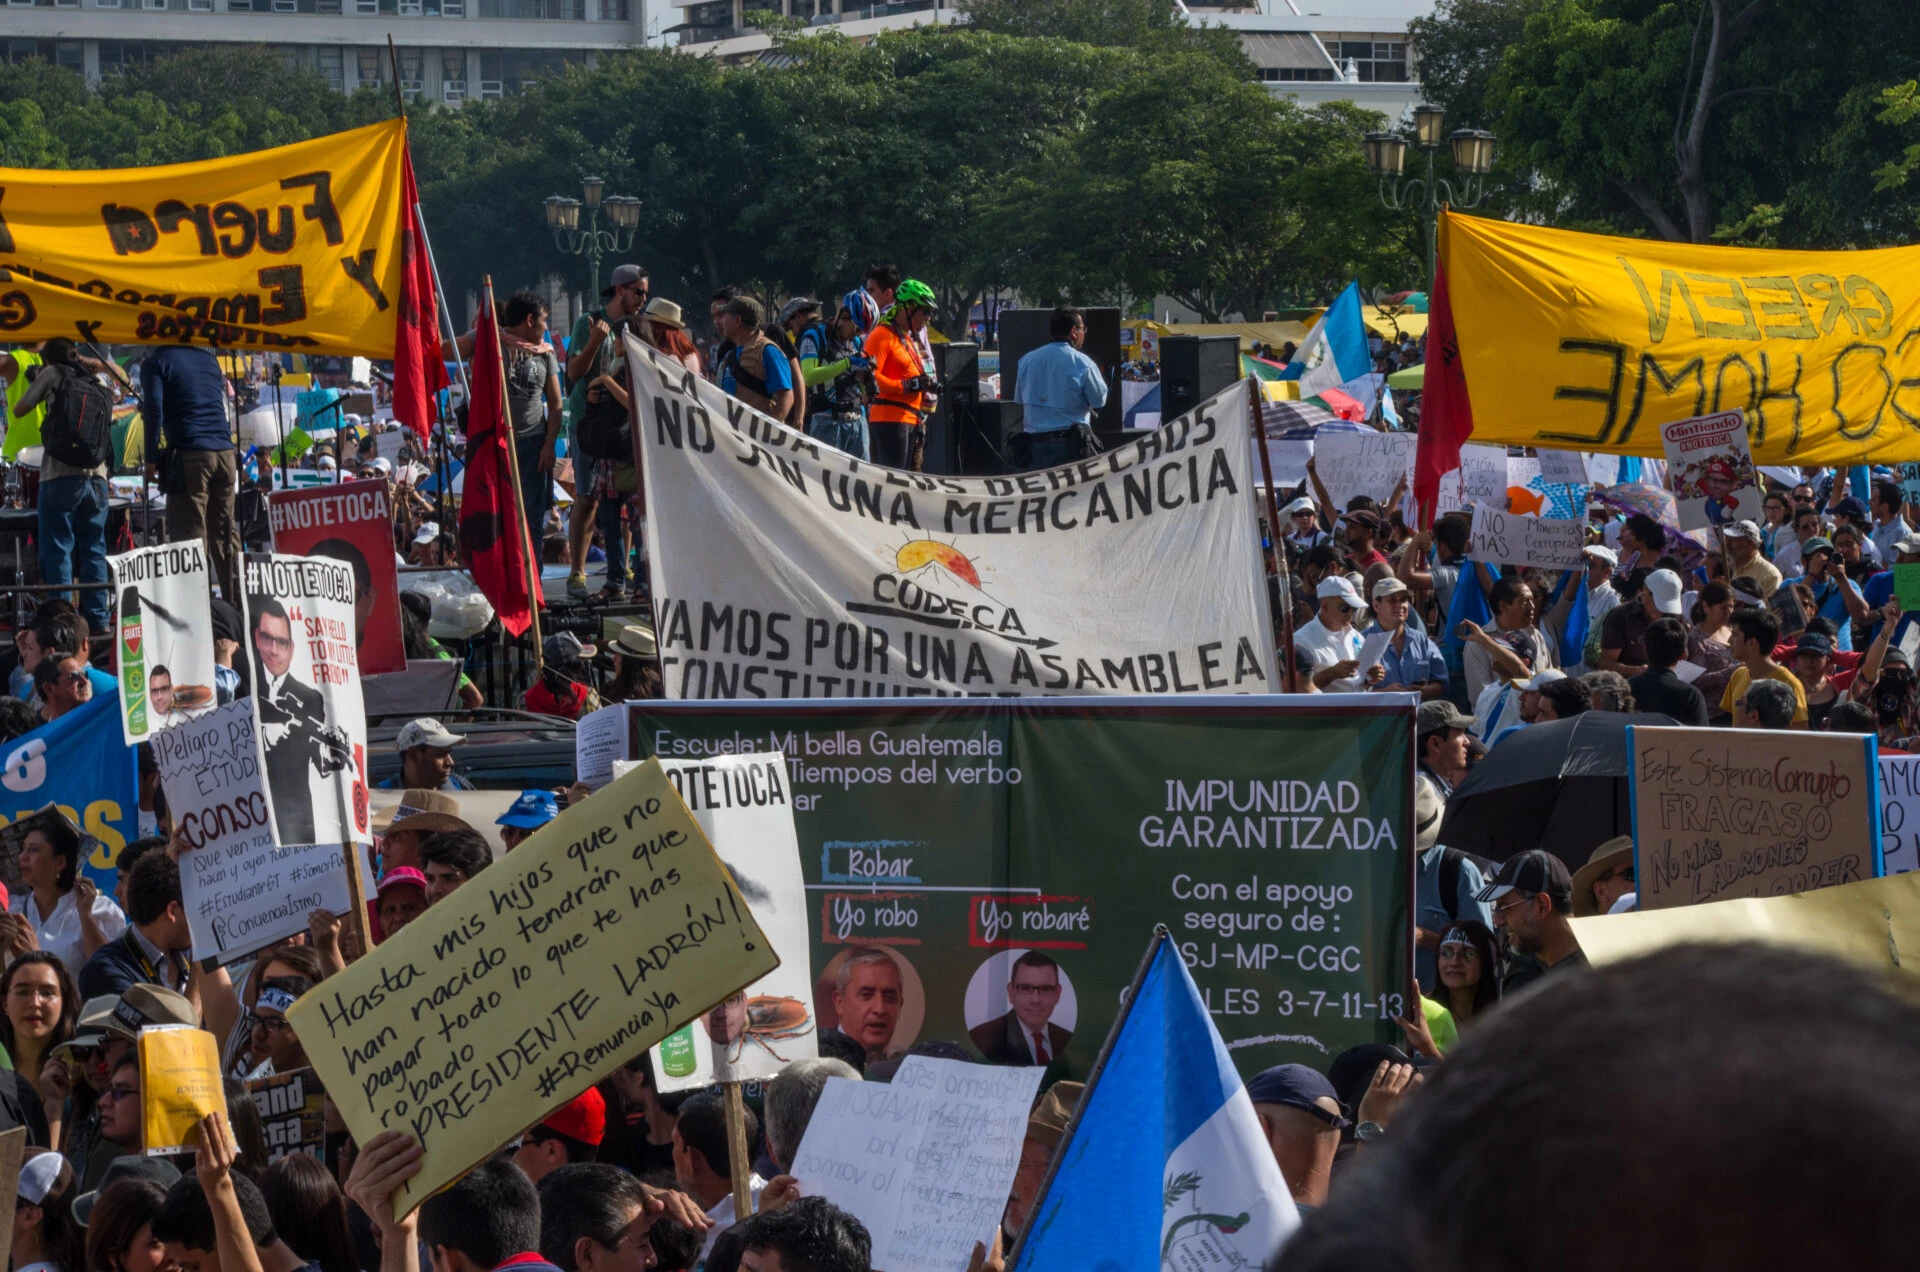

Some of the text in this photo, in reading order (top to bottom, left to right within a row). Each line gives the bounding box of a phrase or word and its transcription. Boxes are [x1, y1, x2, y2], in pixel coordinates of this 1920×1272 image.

[727, 397, 821, 461] VIDA
[984, 399, 1218, 497] DERECHOS
[1680, 433, 1732, 452] #NOTETOCA
[654, 396, 716, 454] NO
[822, 469, 922, 530] UNA
[943, 447, 1238, 534] MERCANCIA
[271, 491, 389, 532] #NOTETOCA
[1480, 510, 1505, 535] NO
[118, 546, 204, 585] #NOTETOCA
[247, 560, 353, 605] #NOTETOCA
[873, 573, 1027, 636] CODECA
[123, 625, 143, 641] GUATE
[308, 640, 327, 661] TO
[805, 617, 889, 674] POR
[905, 631, 993, 684] UNA
[1010, 635, 1266, 693] ASAMBLEA
[655, 730, 1004, 756] Escuela: Mi bella Guatemala
[195, 755, 260, 797] ESTUDI
[787, 758, 1023, 790] Tiempos del verbo
[1641, 747, 1851, 803] Este Sistema Corrupto
[1165, 779, 1361, 813] IMPUNIDAD
[1140, 815, 1398, 850] GARANTIZADA
[230, 864, 238, 882] y
[848, 848, 914, 878] Robar
[1691, 835, 1809, 904] LADRONES
[1172, 874, 1353, 910] Con el apoyo
[319, 961, 426, 1038] Hasta
[432, 913, 487, 963] mis
[490, 861, 554, 916] hijos
[567, 823, 619, 870] que
[623, 796, 662, 830] no
[834, 898, 918, 939] Yo robo
[980, 899, 1091, 943] Yo robaré
[1184, 910, 1283, 937] seguro
[342, 829, 689, 1076] han nacido tendrán que
[1177, 942, 1361, 972] SJ-MP-CGC
[361, 866, 682, 1113] pagar todo lo que te has
[1278, 990, 1404, 1020] 3-7-11-13
[534, 990, 681, 1099] #RenunciaYa
[379, 1044, 476, 1128] robado
